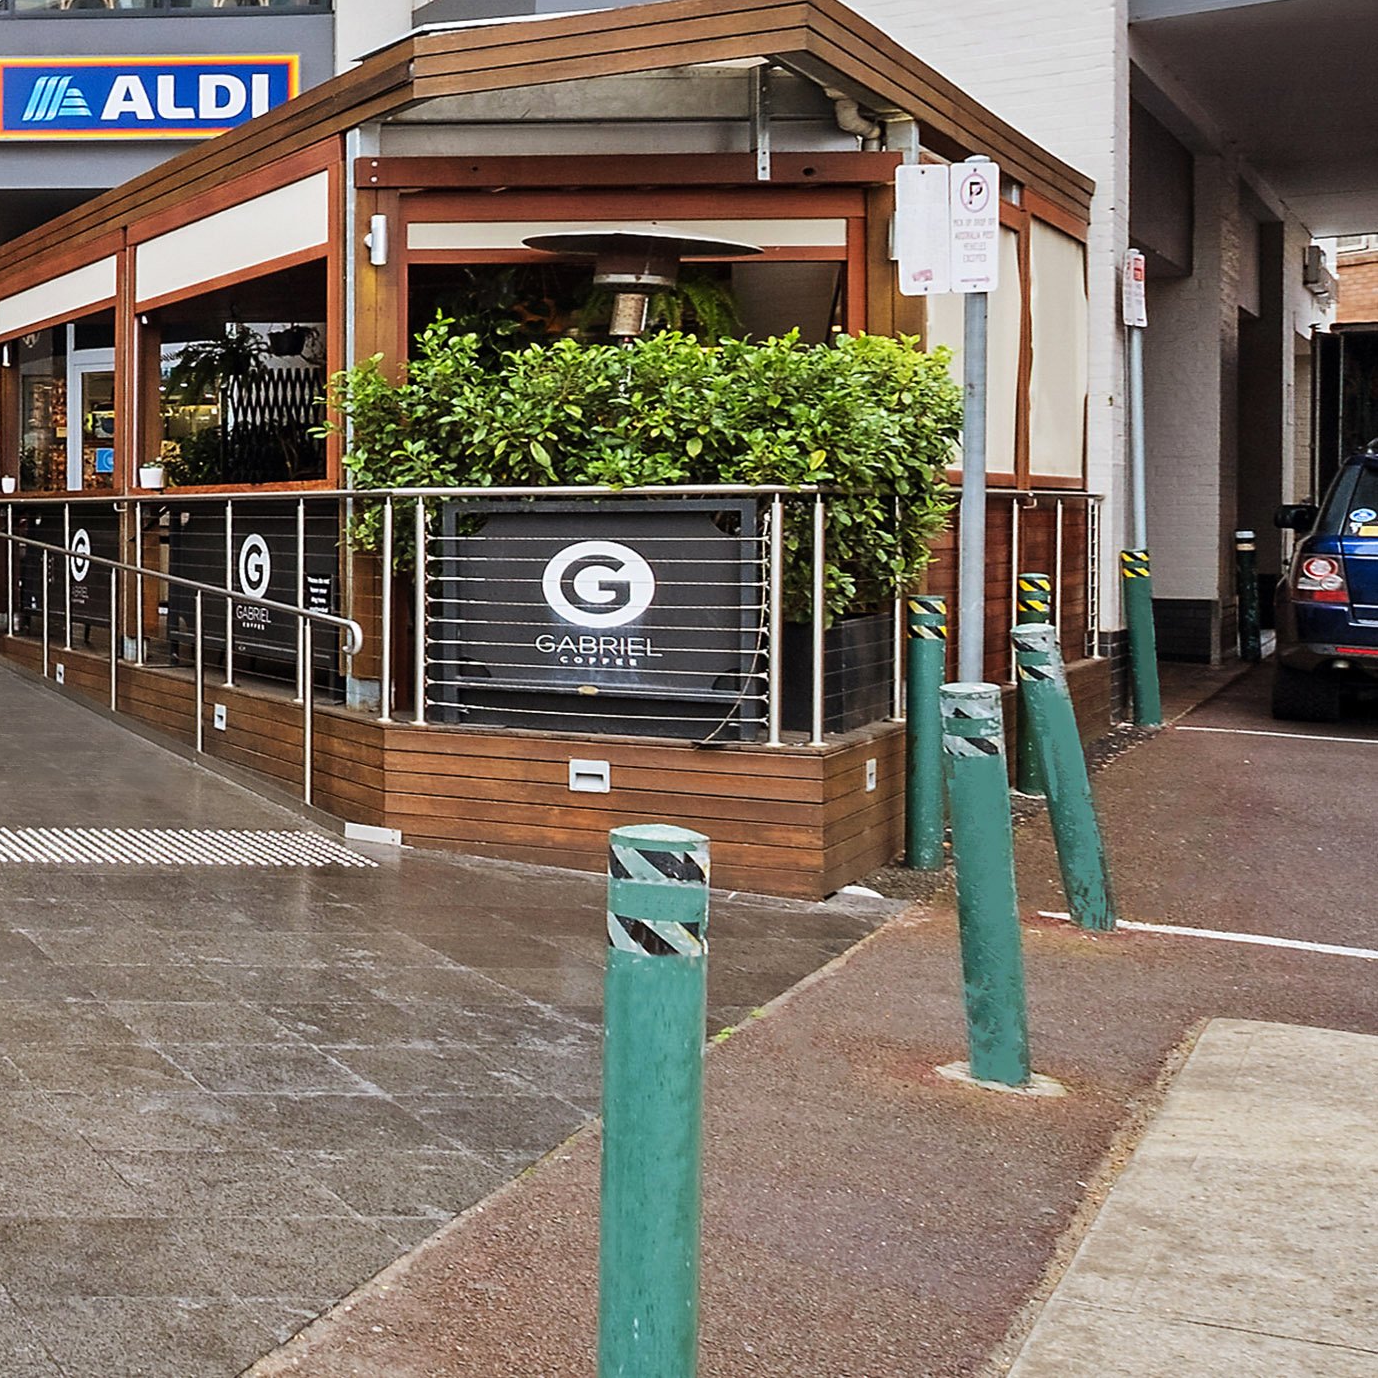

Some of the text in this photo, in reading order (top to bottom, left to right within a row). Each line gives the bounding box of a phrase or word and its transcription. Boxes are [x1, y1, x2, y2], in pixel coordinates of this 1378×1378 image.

[100, 74, 270, 120] ALDI
[236, 604, 272, 623] GABRIEL
[535, 634, 663, 657] GABRIEL
[560, 655, 638, 666] COFFEE
